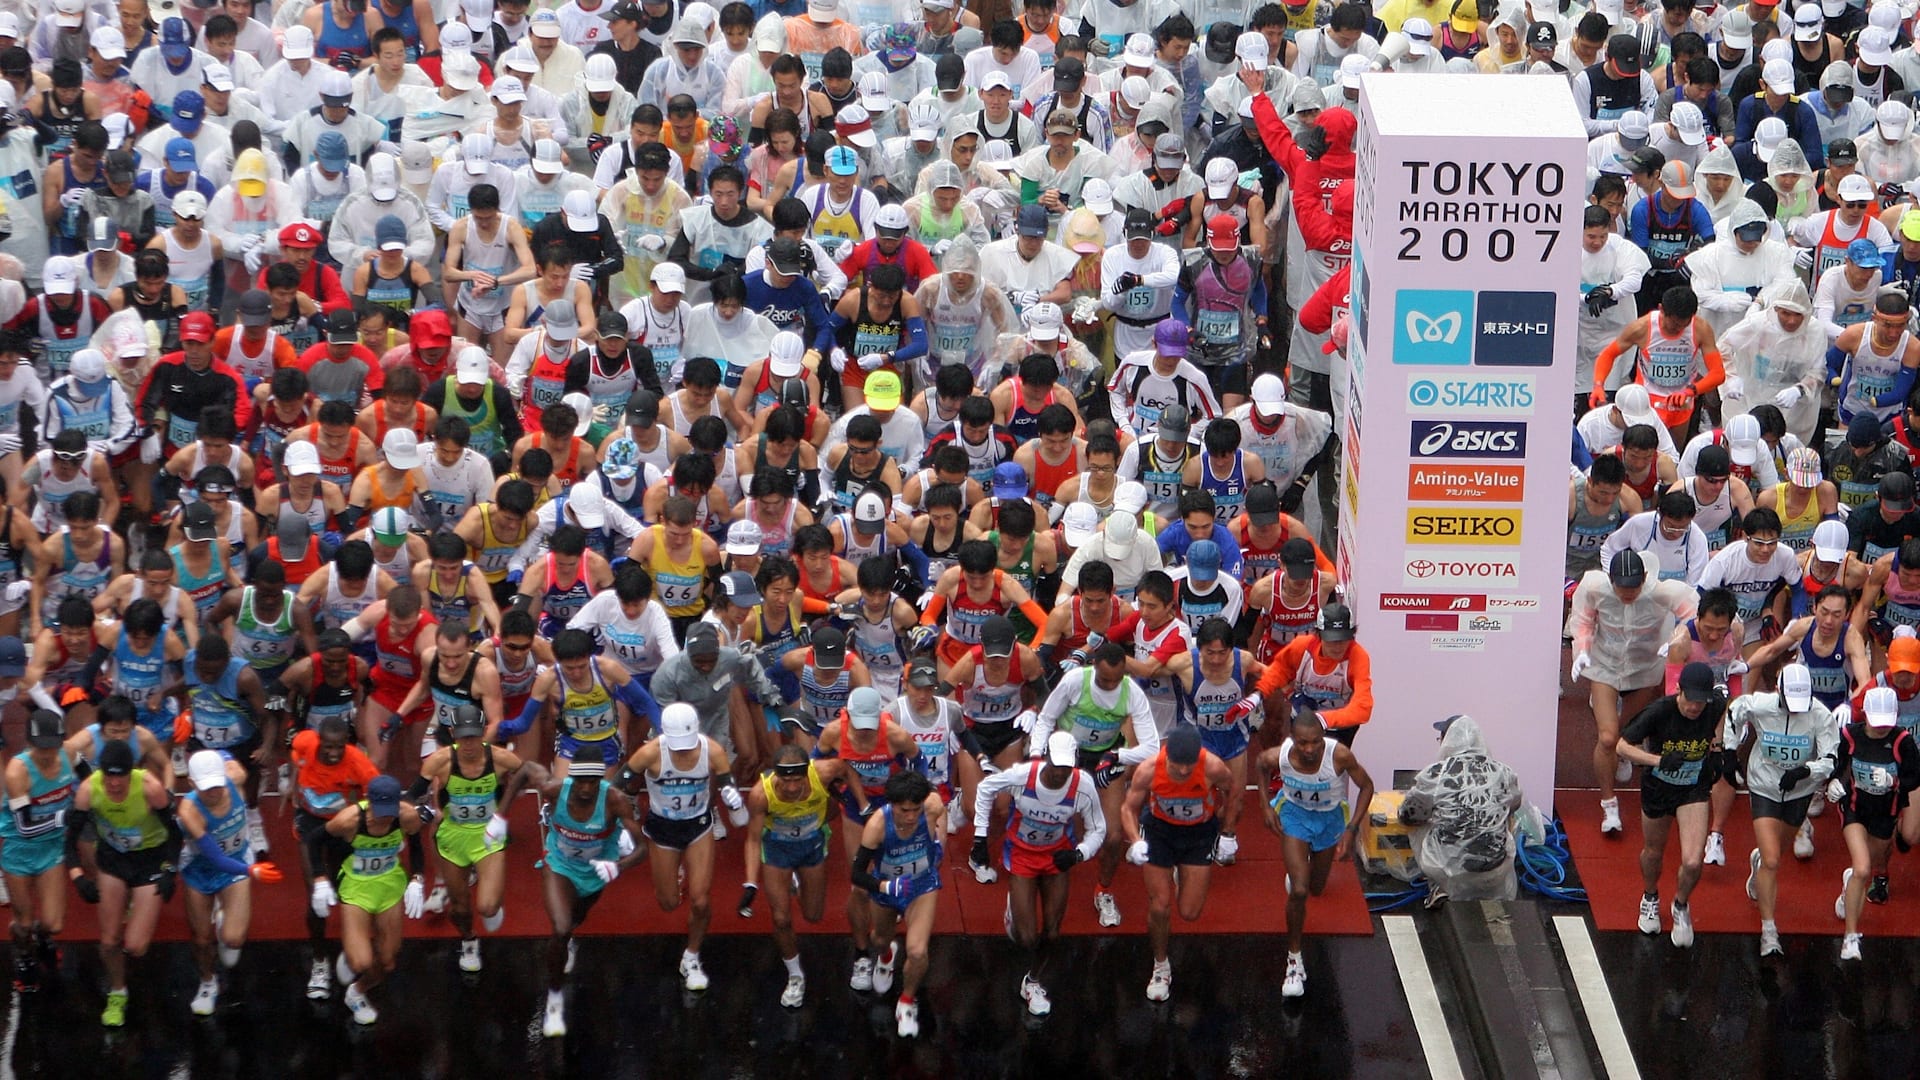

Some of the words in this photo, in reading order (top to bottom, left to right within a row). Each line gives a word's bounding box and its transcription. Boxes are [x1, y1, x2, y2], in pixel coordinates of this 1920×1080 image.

[1402, 161, 1564, 197] TOKYO
[1399, 201, 1562, 223] MARATHON
[1397, 227, 1560, 262] 2007
[1483, 322, 1548, 335] 東京メトロ
[1652, 364, 1686, 378] 10335
[1442, 381, 1533, 408] STARTS
[1451, 430, 1517, 452] asics
[1414, 470, 1519, 487] Amino-Value
[1413, 516, 1515, 536] SEIKO
[1438, 563, 1516, 577] TOYOTA
[664, 586, 690, 600] 66
[1384, 597, 1430, 606] KONAMI
[1448, 597, 1471, 609] JTB
[958, 608, 997, 616] ENEOS
[251, 642, 277, 653] 63
[573, 714, 608, 730] 156
[205, 728, 228, 742] 67
[1090, 729, 1100, 743] 5
[1768, 746, 1800, 761] F50
[1293, 790, 1320, 802] 44
[671, 795, 698, 812] 34
[459, 806, 486, 819] 33
[1029, 809, 1060, 822] NTN
[1027, 829, 1055, 841] 65
[893, 862, 917, 875] 31
